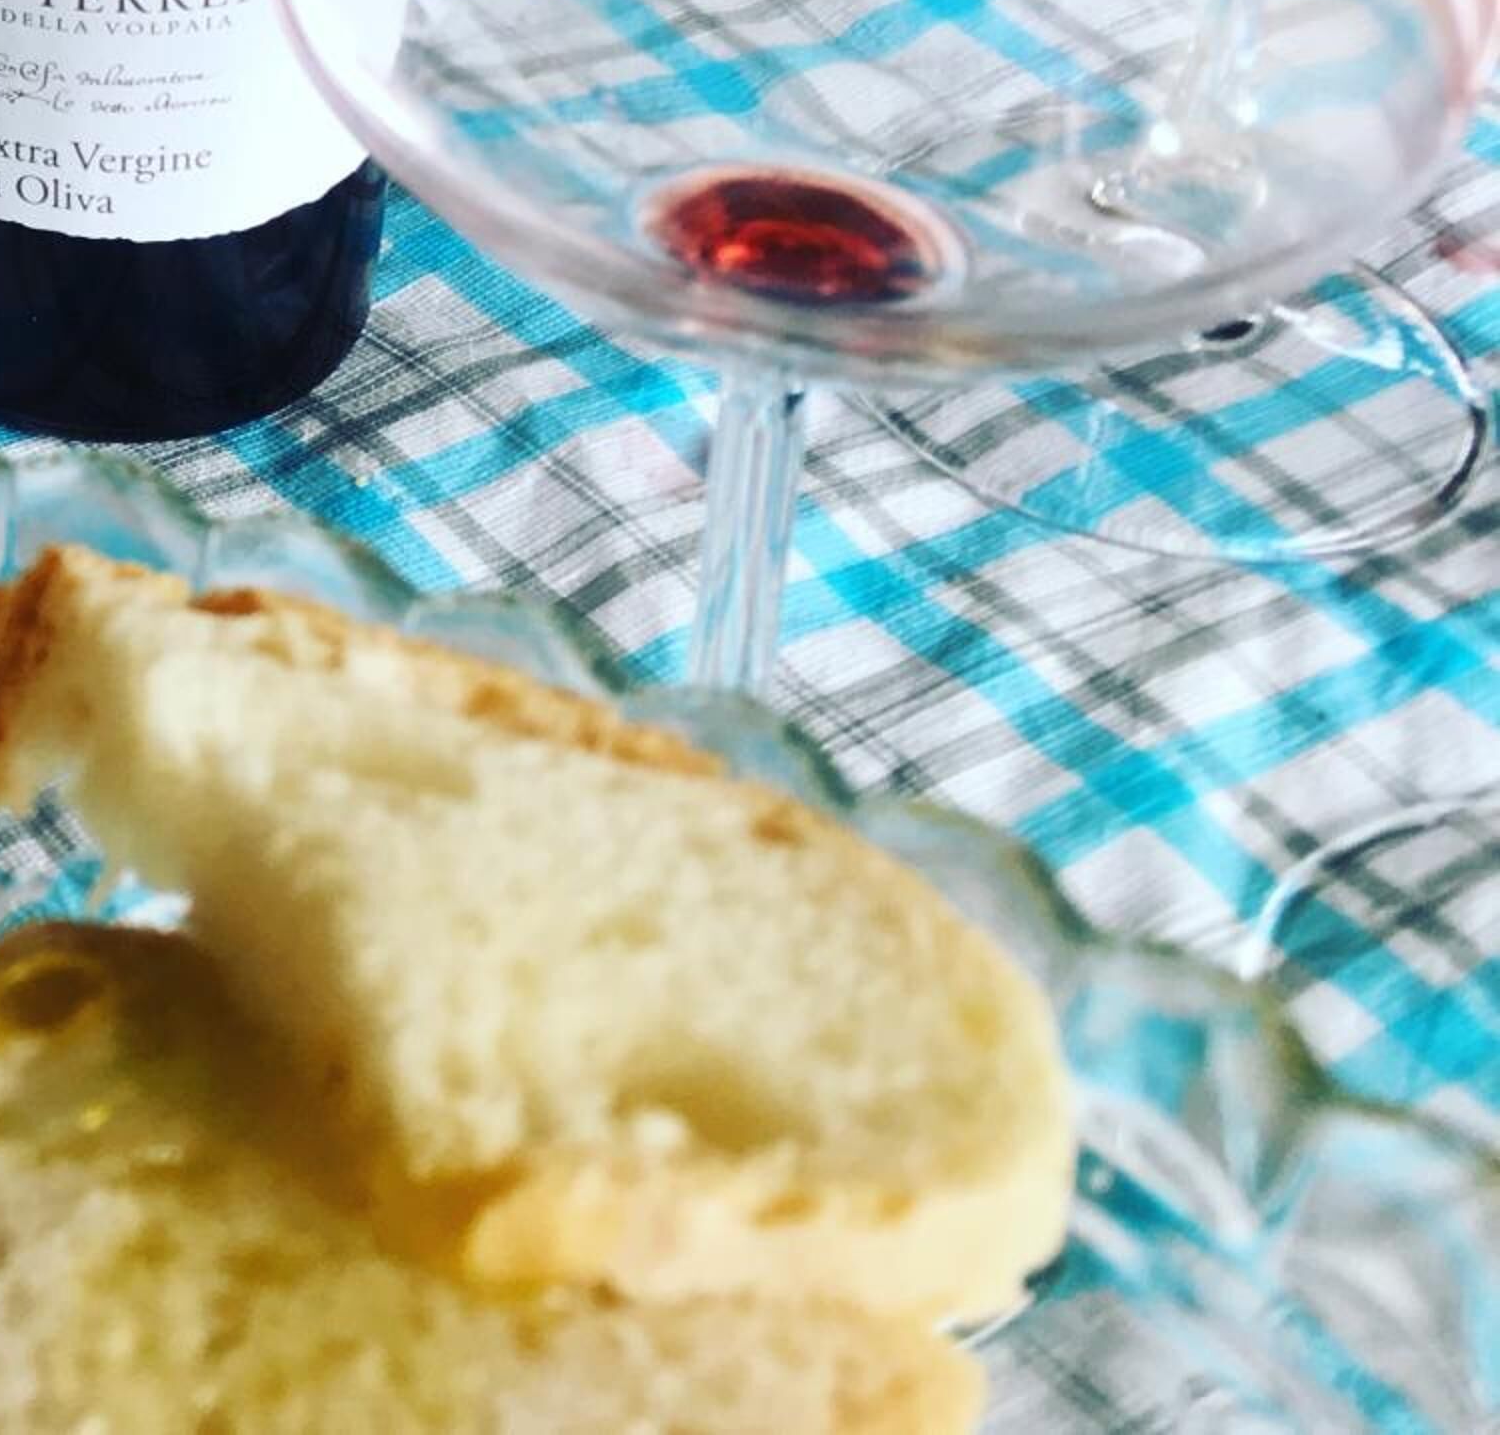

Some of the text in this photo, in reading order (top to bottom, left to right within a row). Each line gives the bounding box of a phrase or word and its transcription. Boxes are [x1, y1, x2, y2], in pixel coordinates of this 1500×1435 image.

[0, 8, 89, 34] DELLA
[104, 14, 233, 36] VOLPAIA
[71, 141, 213, 184] Vergine
[14, 173, 116, 215] Oliva
